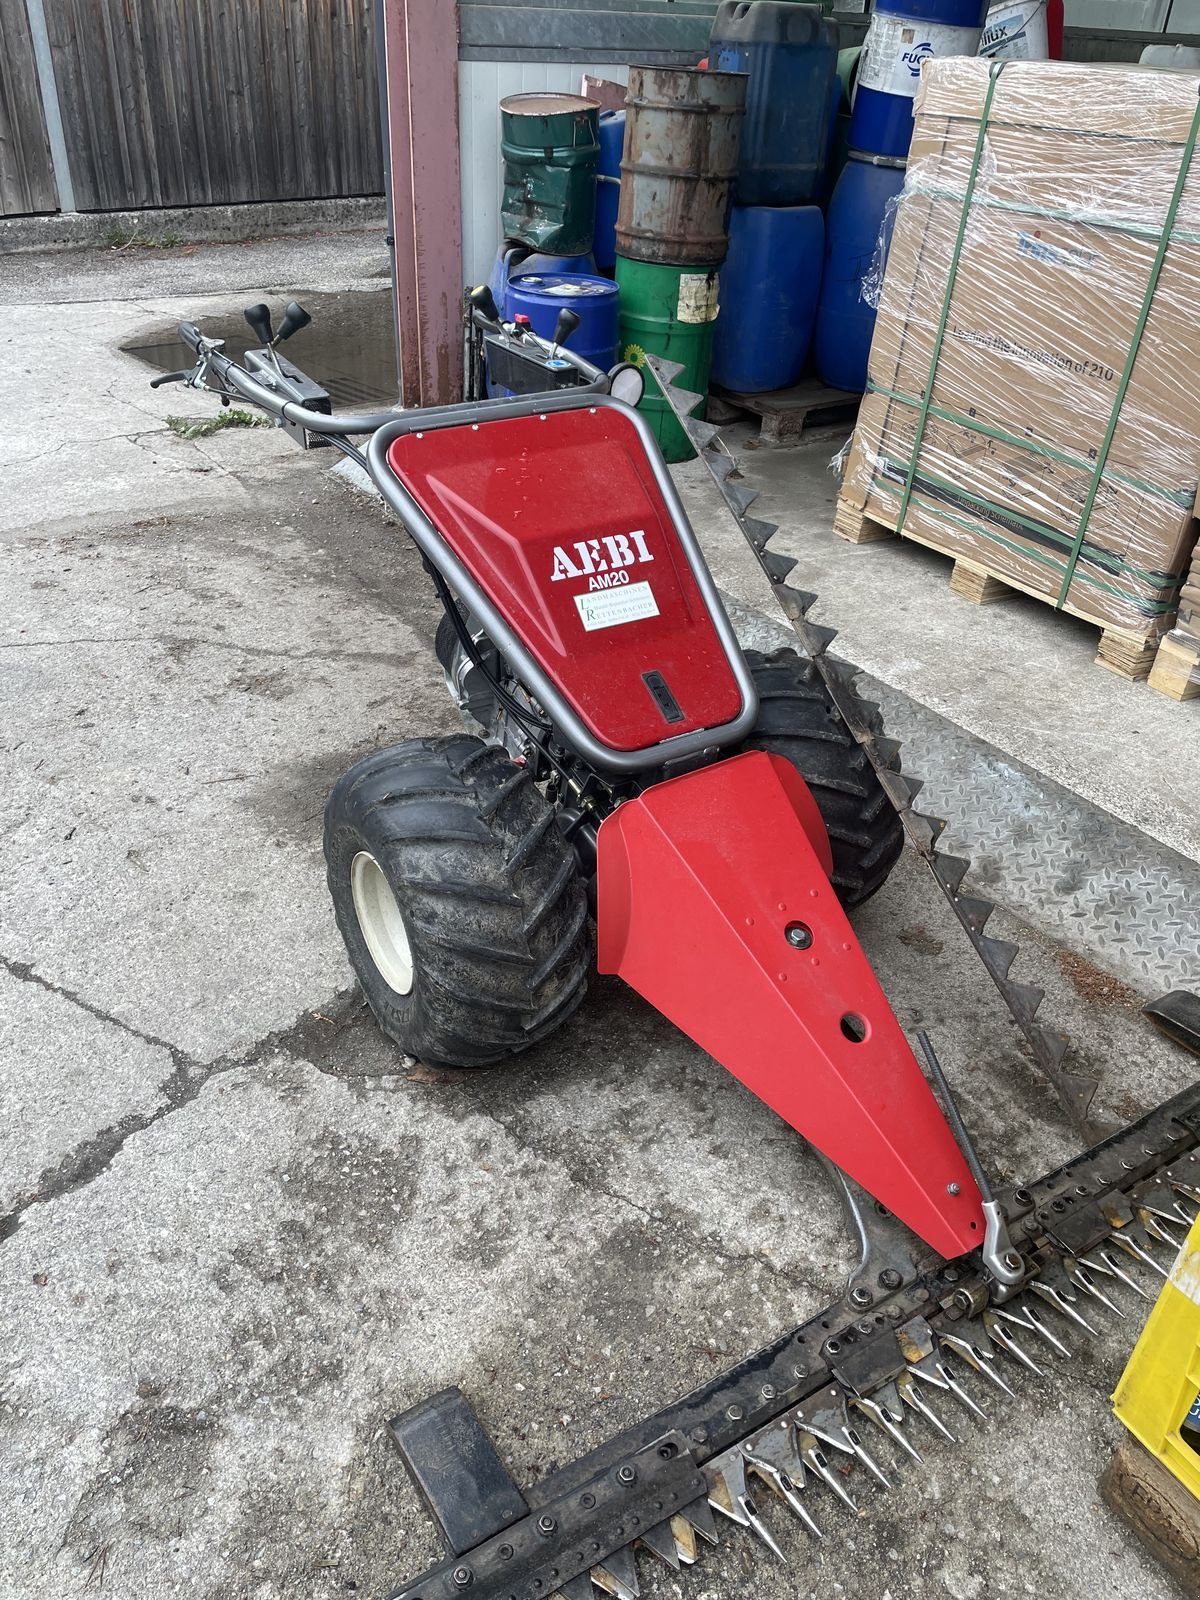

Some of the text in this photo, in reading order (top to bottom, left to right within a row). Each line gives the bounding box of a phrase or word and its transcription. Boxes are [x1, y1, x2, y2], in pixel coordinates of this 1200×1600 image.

[901, 52, 930, 64] FUC
[1074, 361, 1089, 375] of
[1089, 363, 1114, 382] 210
[550, 530, 655, 582] AEBI
[589, 570, 630, 591] AM20
